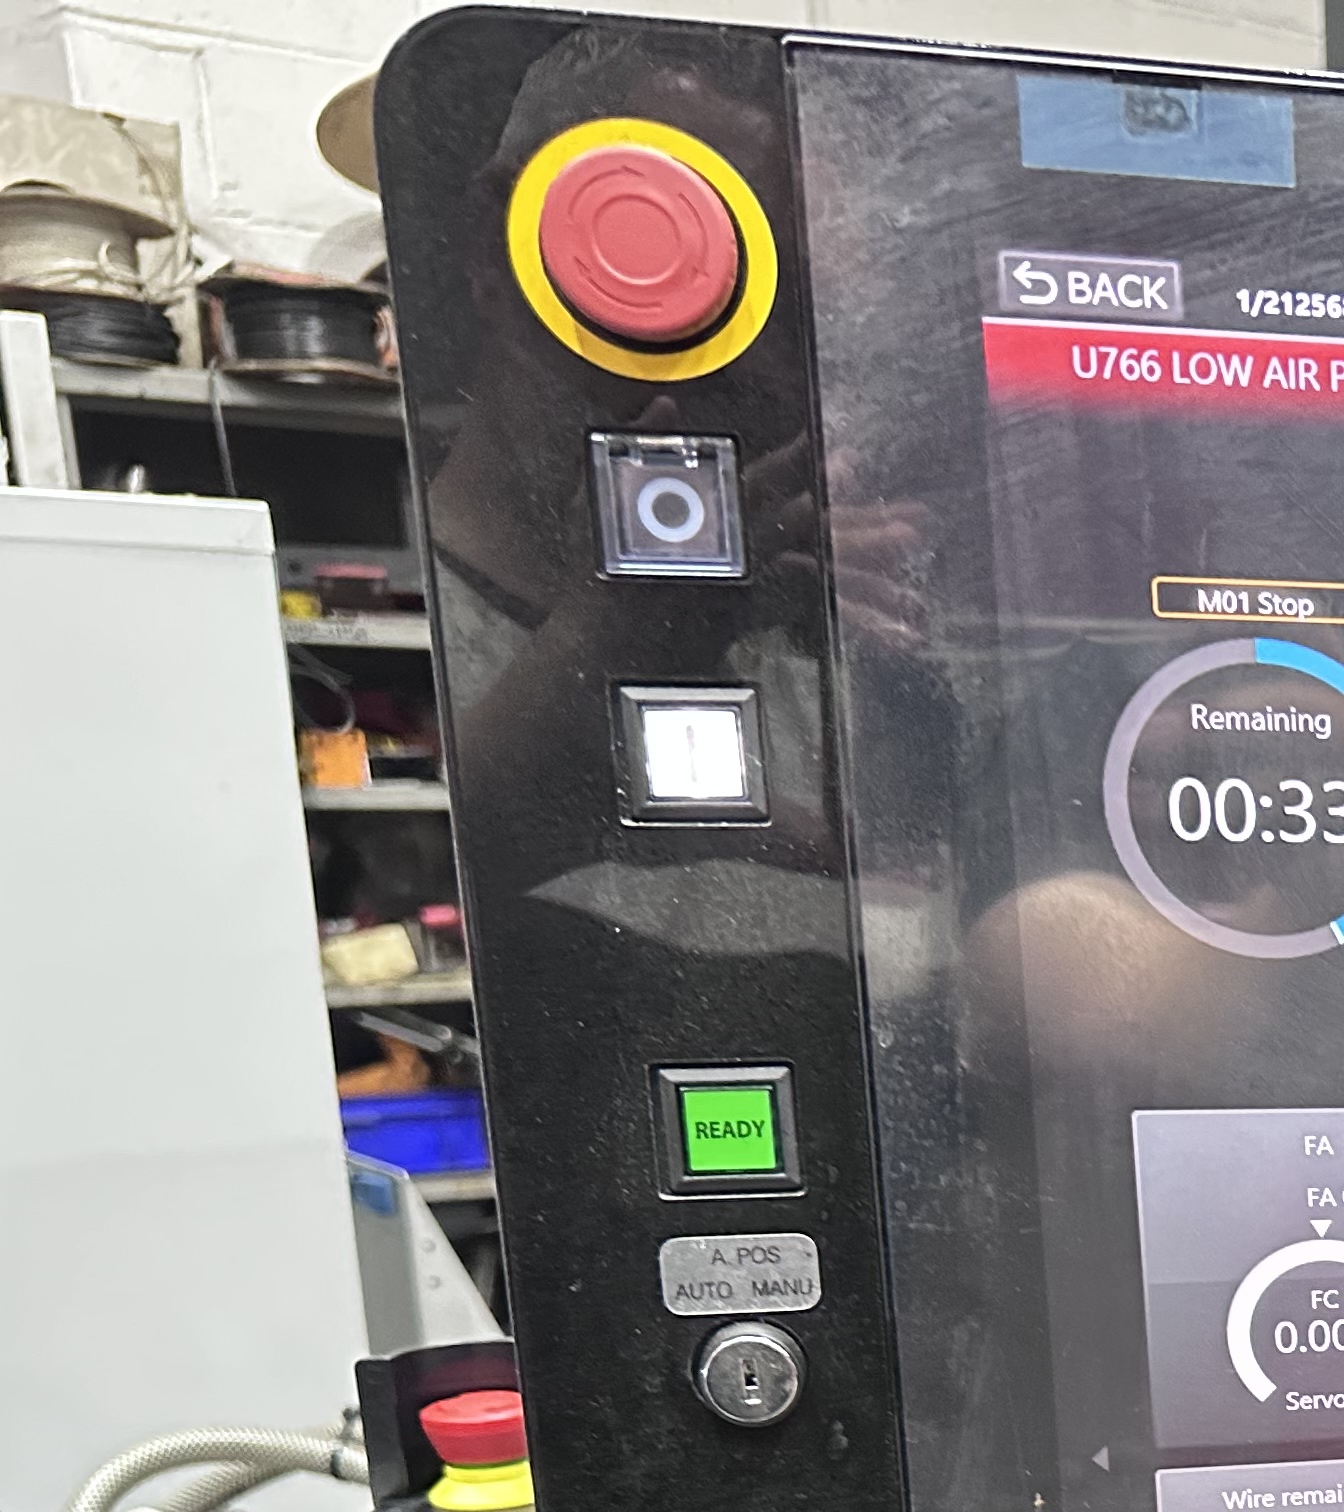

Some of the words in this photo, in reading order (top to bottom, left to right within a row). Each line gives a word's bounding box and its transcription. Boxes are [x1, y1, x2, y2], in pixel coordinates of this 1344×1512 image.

[1068, 272, 1168, 309] BACK
[1072, 346, 1161, 382] U766
[1172, 352, 1255, 387] LOW
[1262, 357, 1321, 391] AIR
[1197, 589, 1250, 614] M01
[1257, 591, 1314, 619] Stop
[1190, 703, 1331, 739] Remaining
[695, 1120, 765, 1139] READY
[1304, 1136, 1334, 1156] FA
[1307, 1189, 1336, 1207] FA
[676, 1281, 734, 1300] AUTO
[752, 1278, 813, 1298] MANU
[1310, 1289, 1340, 1311] FC
[1222, 1488, 1276, 1509] Wire
